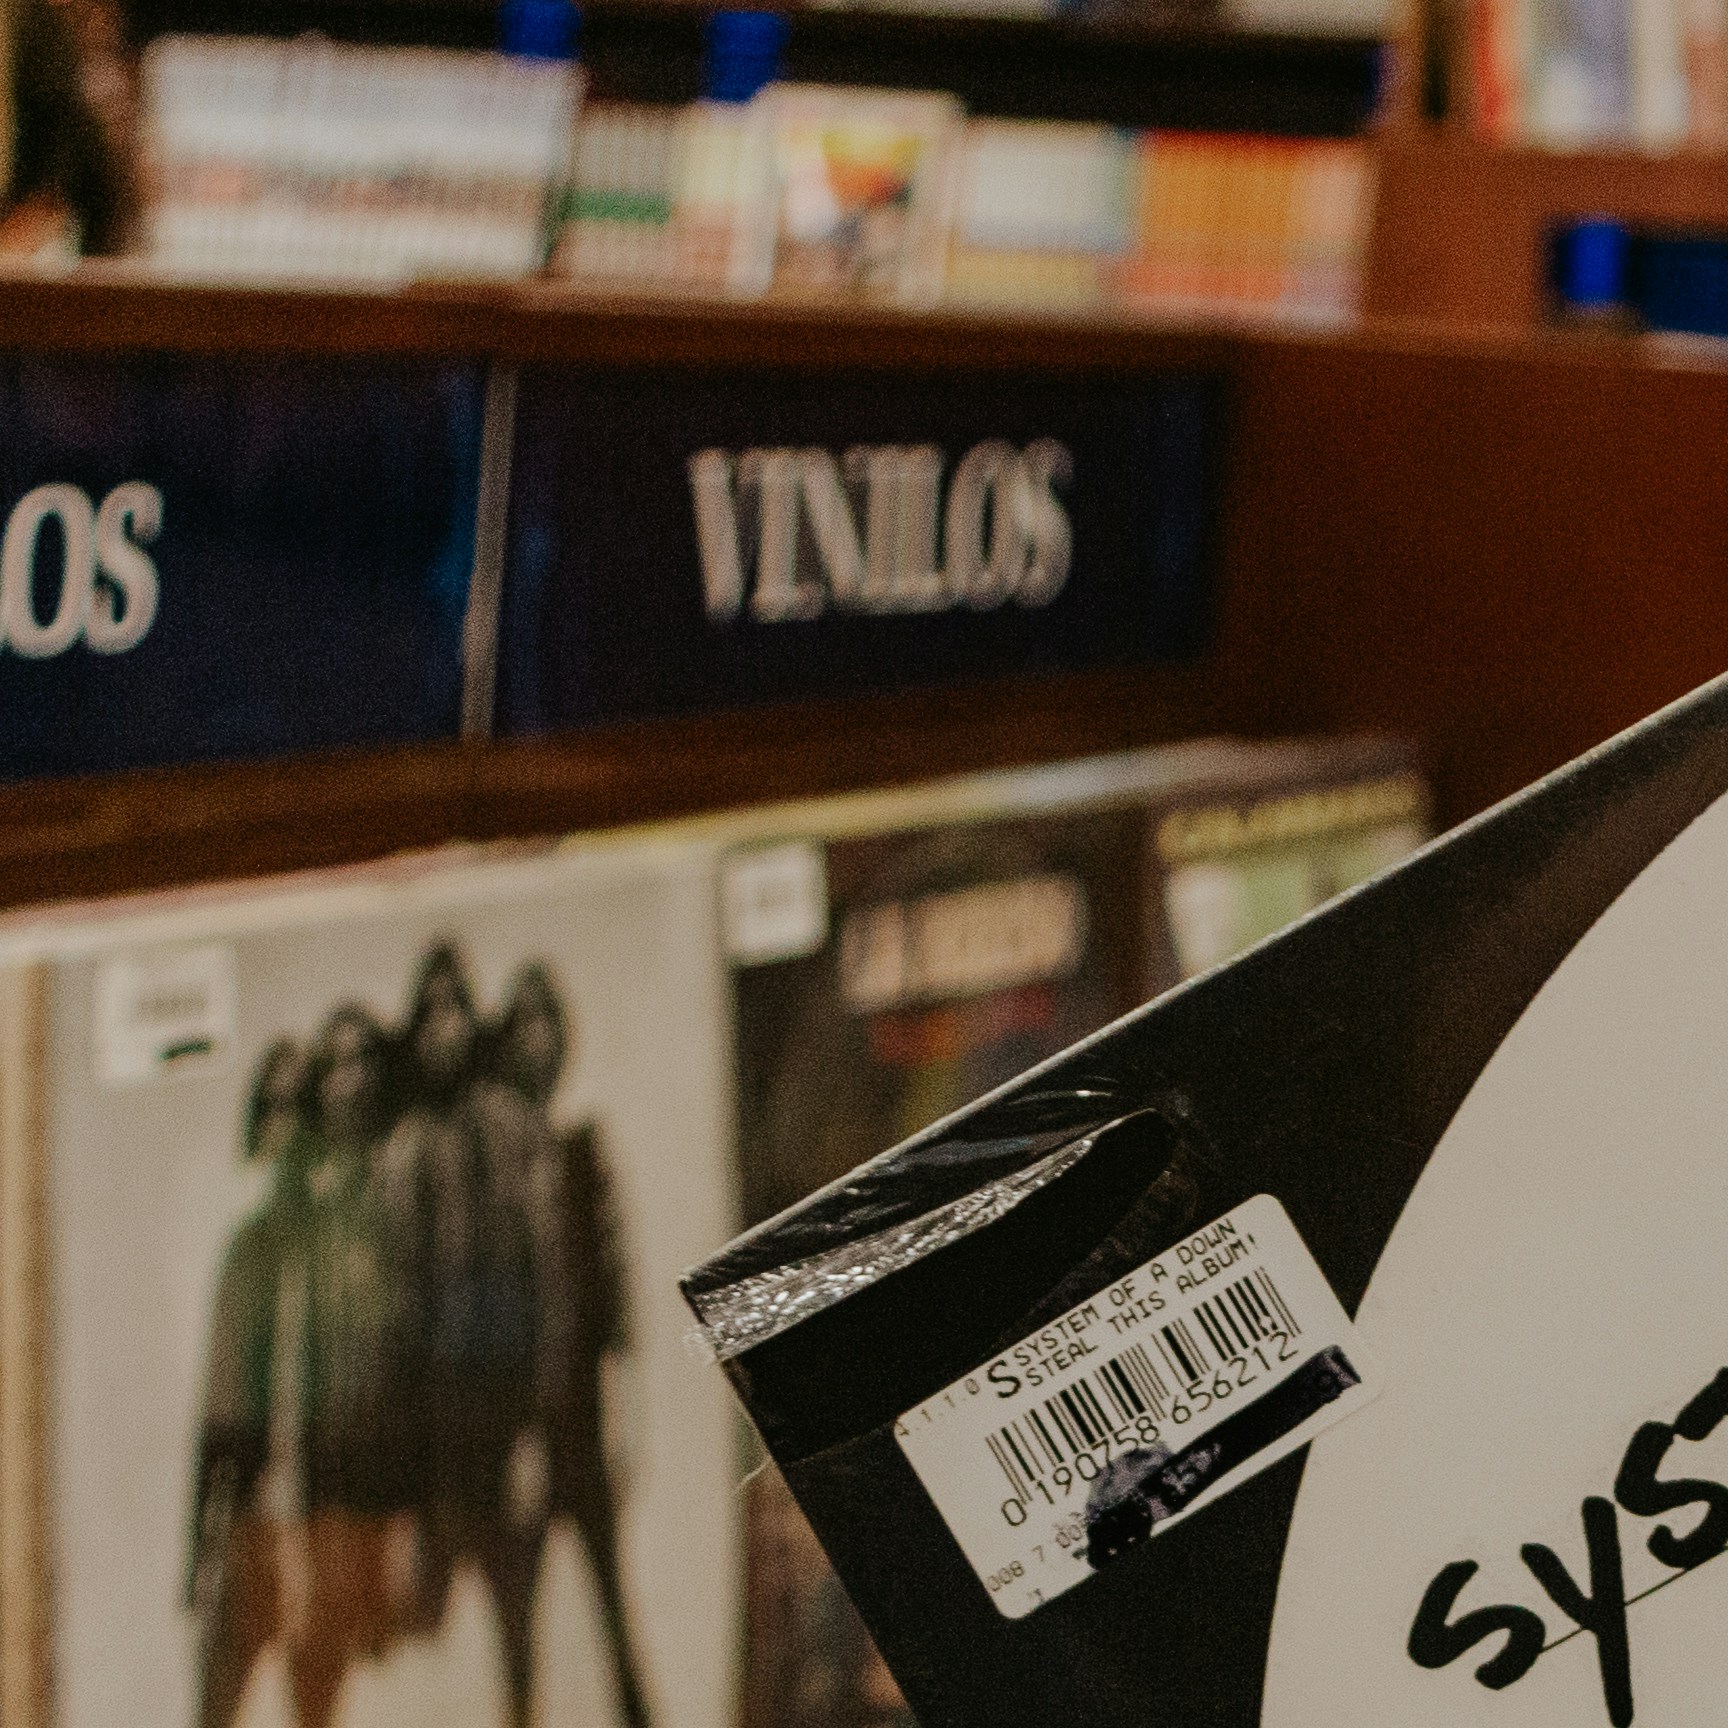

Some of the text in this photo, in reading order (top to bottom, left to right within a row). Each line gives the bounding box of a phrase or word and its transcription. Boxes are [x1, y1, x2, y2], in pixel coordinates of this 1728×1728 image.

[0, 481, 164, 659] OS
[687, 437, 1073, 623] VINILOS
[1014, 1218, 1236, 1368] SYSTEM OF A DOWN
[1026, 1233, 1256, 1386] STEAL THIS ALBUM!
